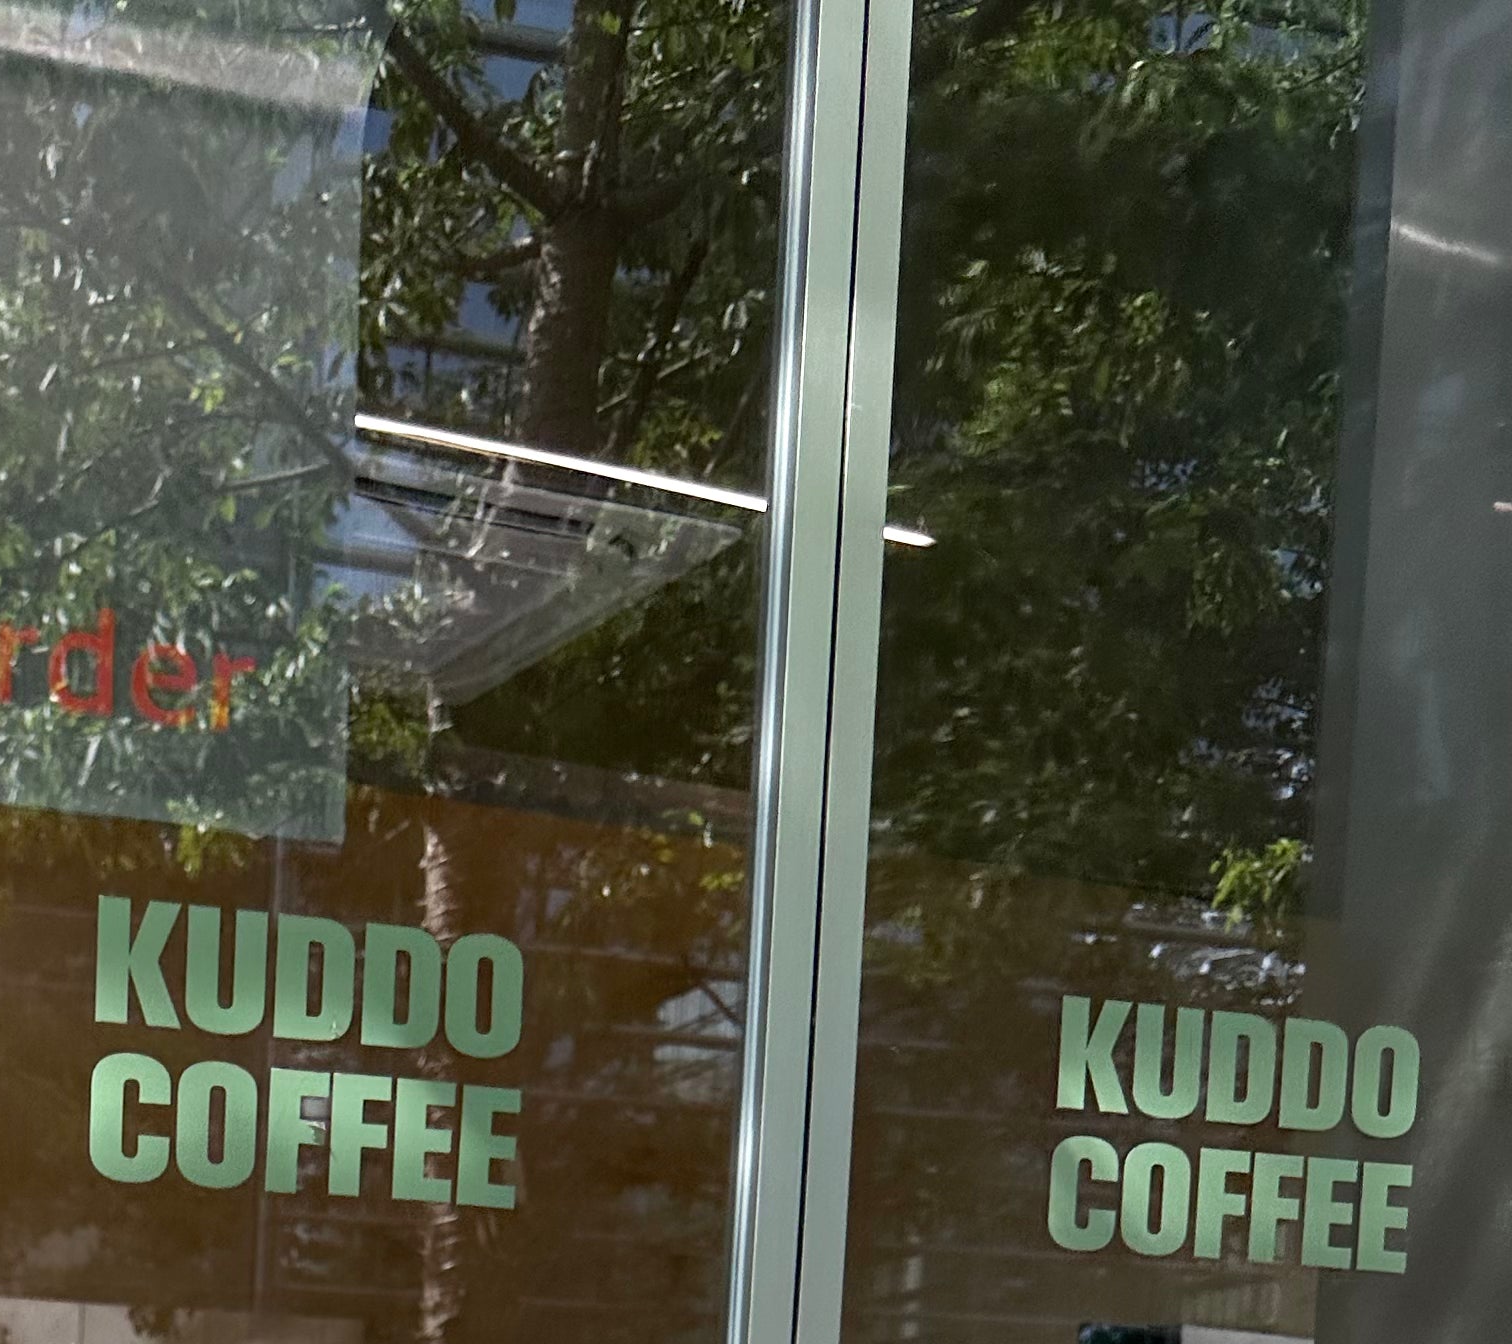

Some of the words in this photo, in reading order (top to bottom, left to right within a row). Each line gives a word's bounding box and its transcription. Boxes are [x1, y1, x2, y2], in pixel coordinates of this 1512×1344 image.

[94, 894, 524, 1059] KUDDO
[88, 1052, 522, 1210] COFFEE
[1056, 995, 1421, 1139] KUDDO
[1046, 1134, 1414, 1275] COFFEE
